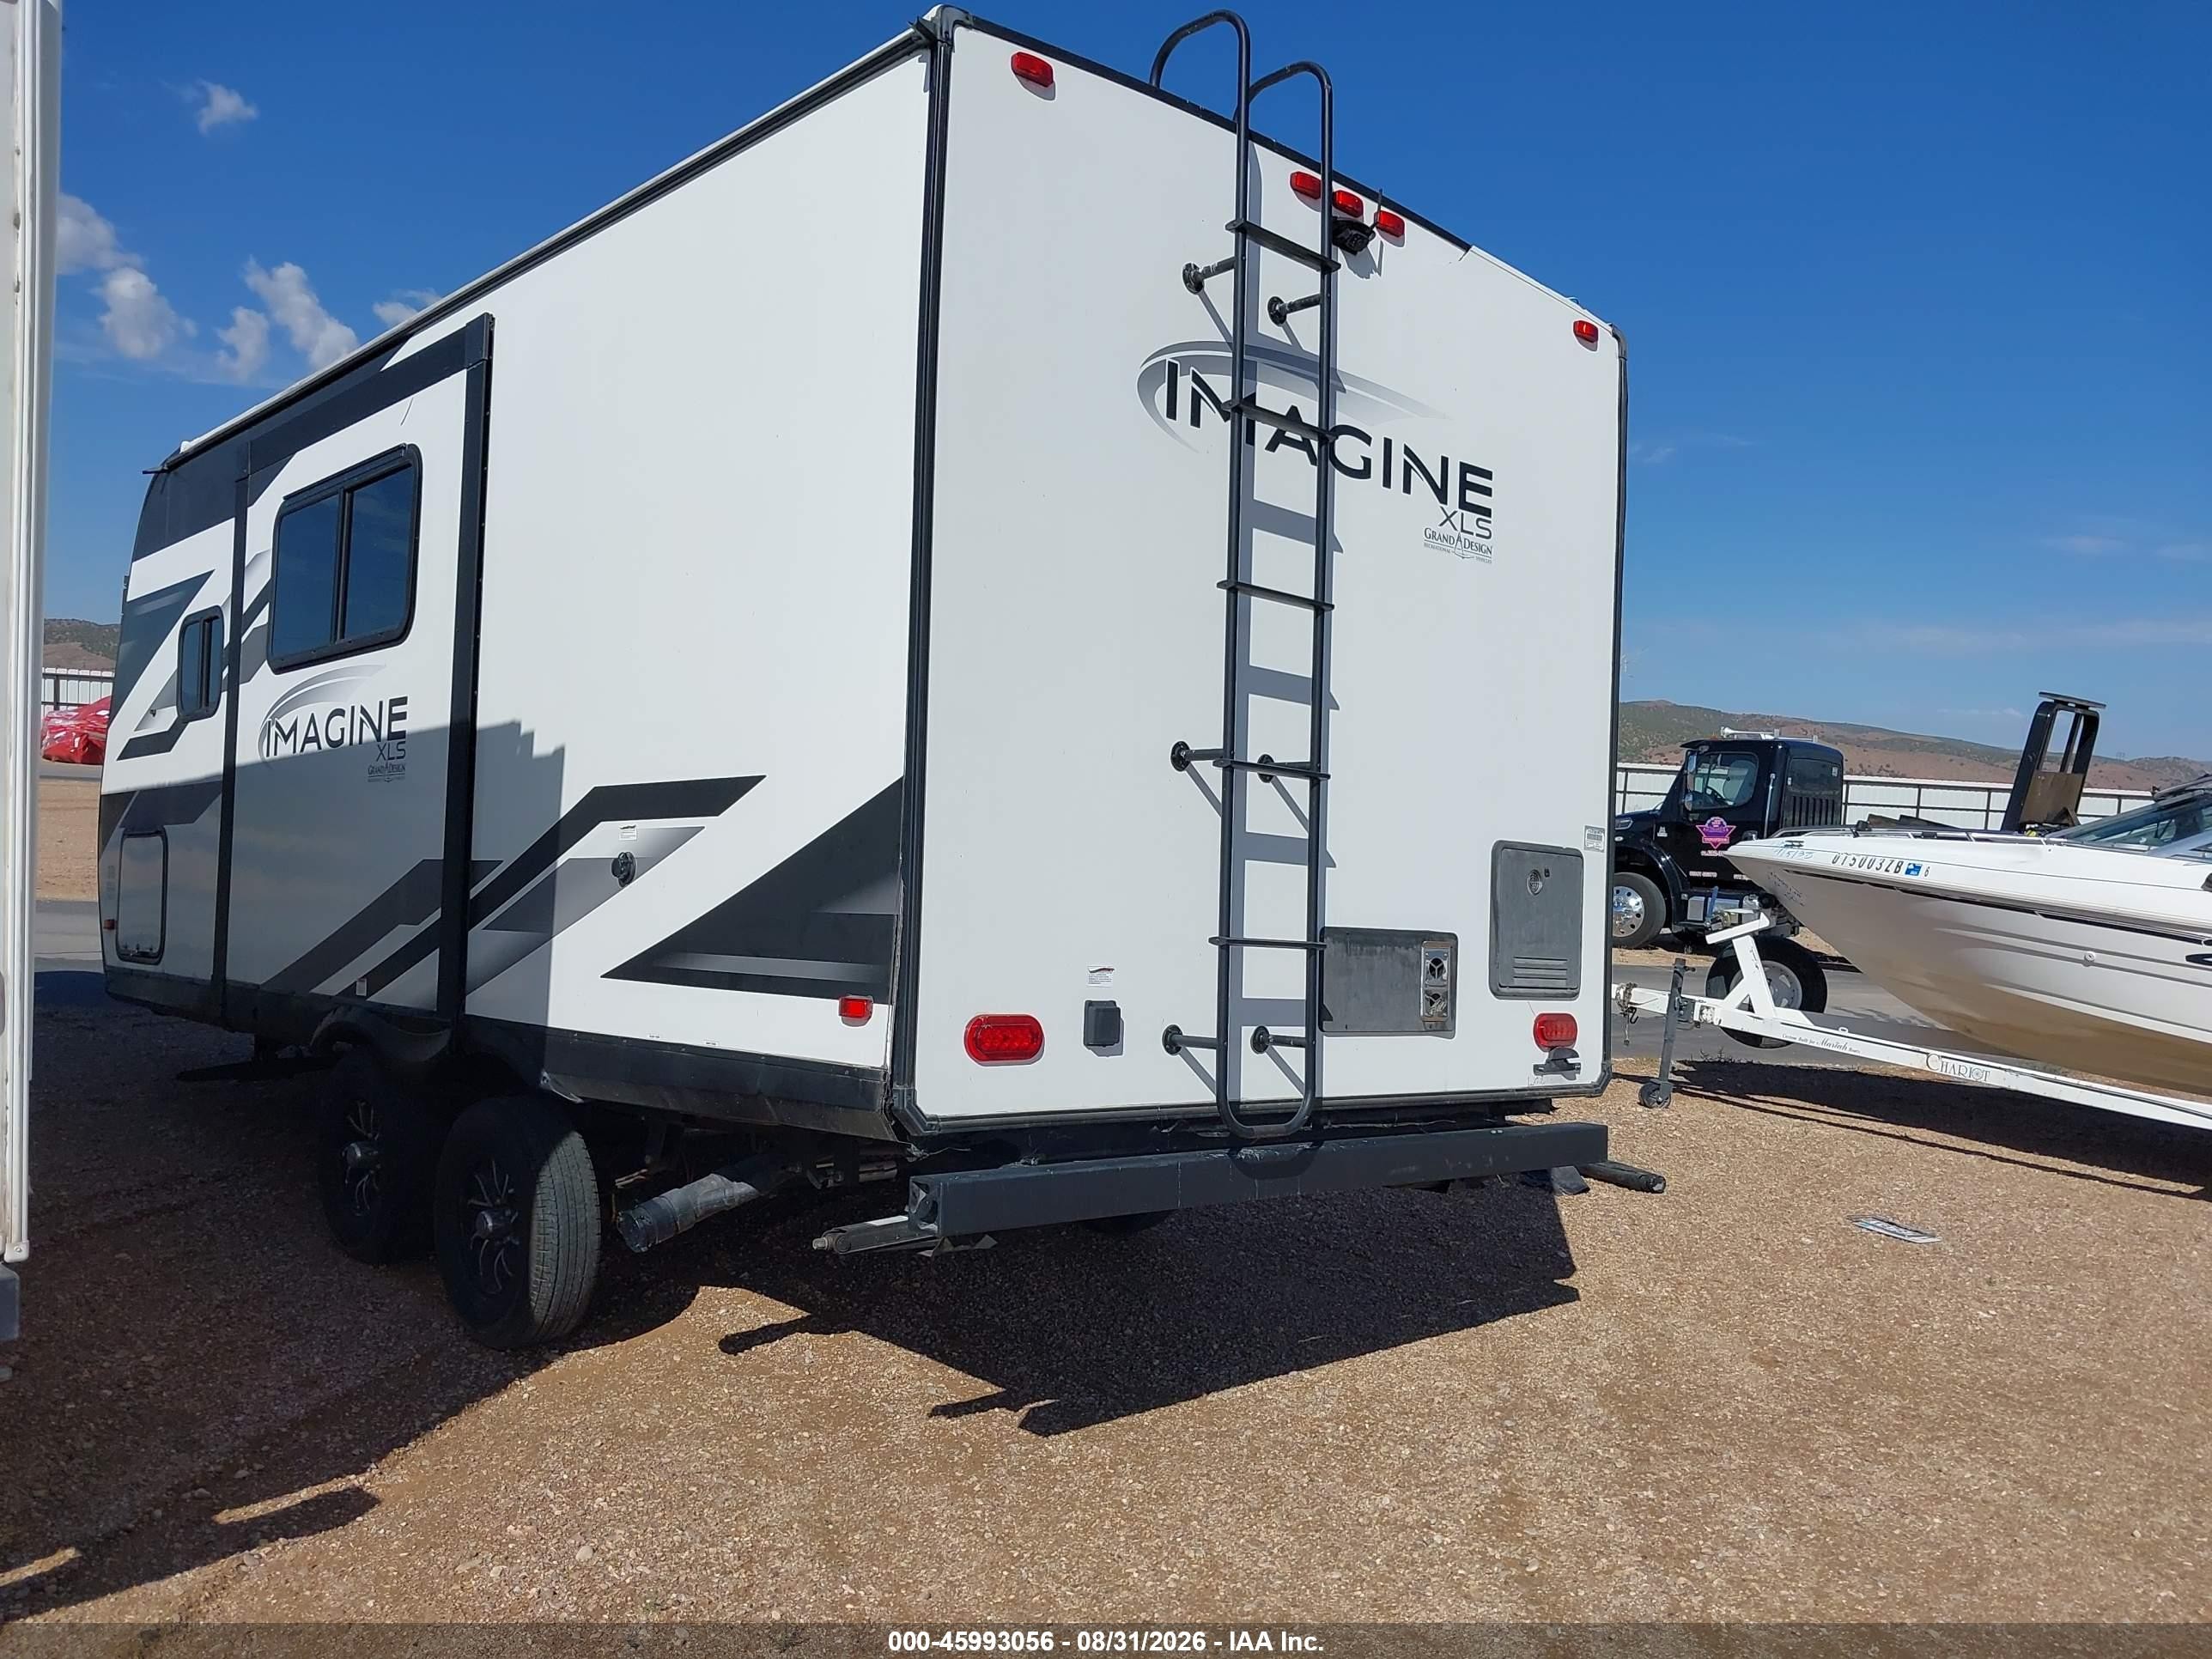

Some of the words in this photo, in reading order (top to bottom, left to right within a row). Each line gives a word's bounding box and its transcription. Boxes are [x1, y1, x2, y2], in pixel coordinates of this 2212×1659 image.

[1166, 360, 1493, 518] IMAGINE
[1438, 506, 1492, 540] XLS
[1424, 527, 1455, 545] GRAND
[1463, 538, 1492, 556] DESIGN
[265, 696, 408, 757] IMAGINE
[376, 741, 406, 762] XLS
[1925, 1053, 1990, 1082] CHARIOT
